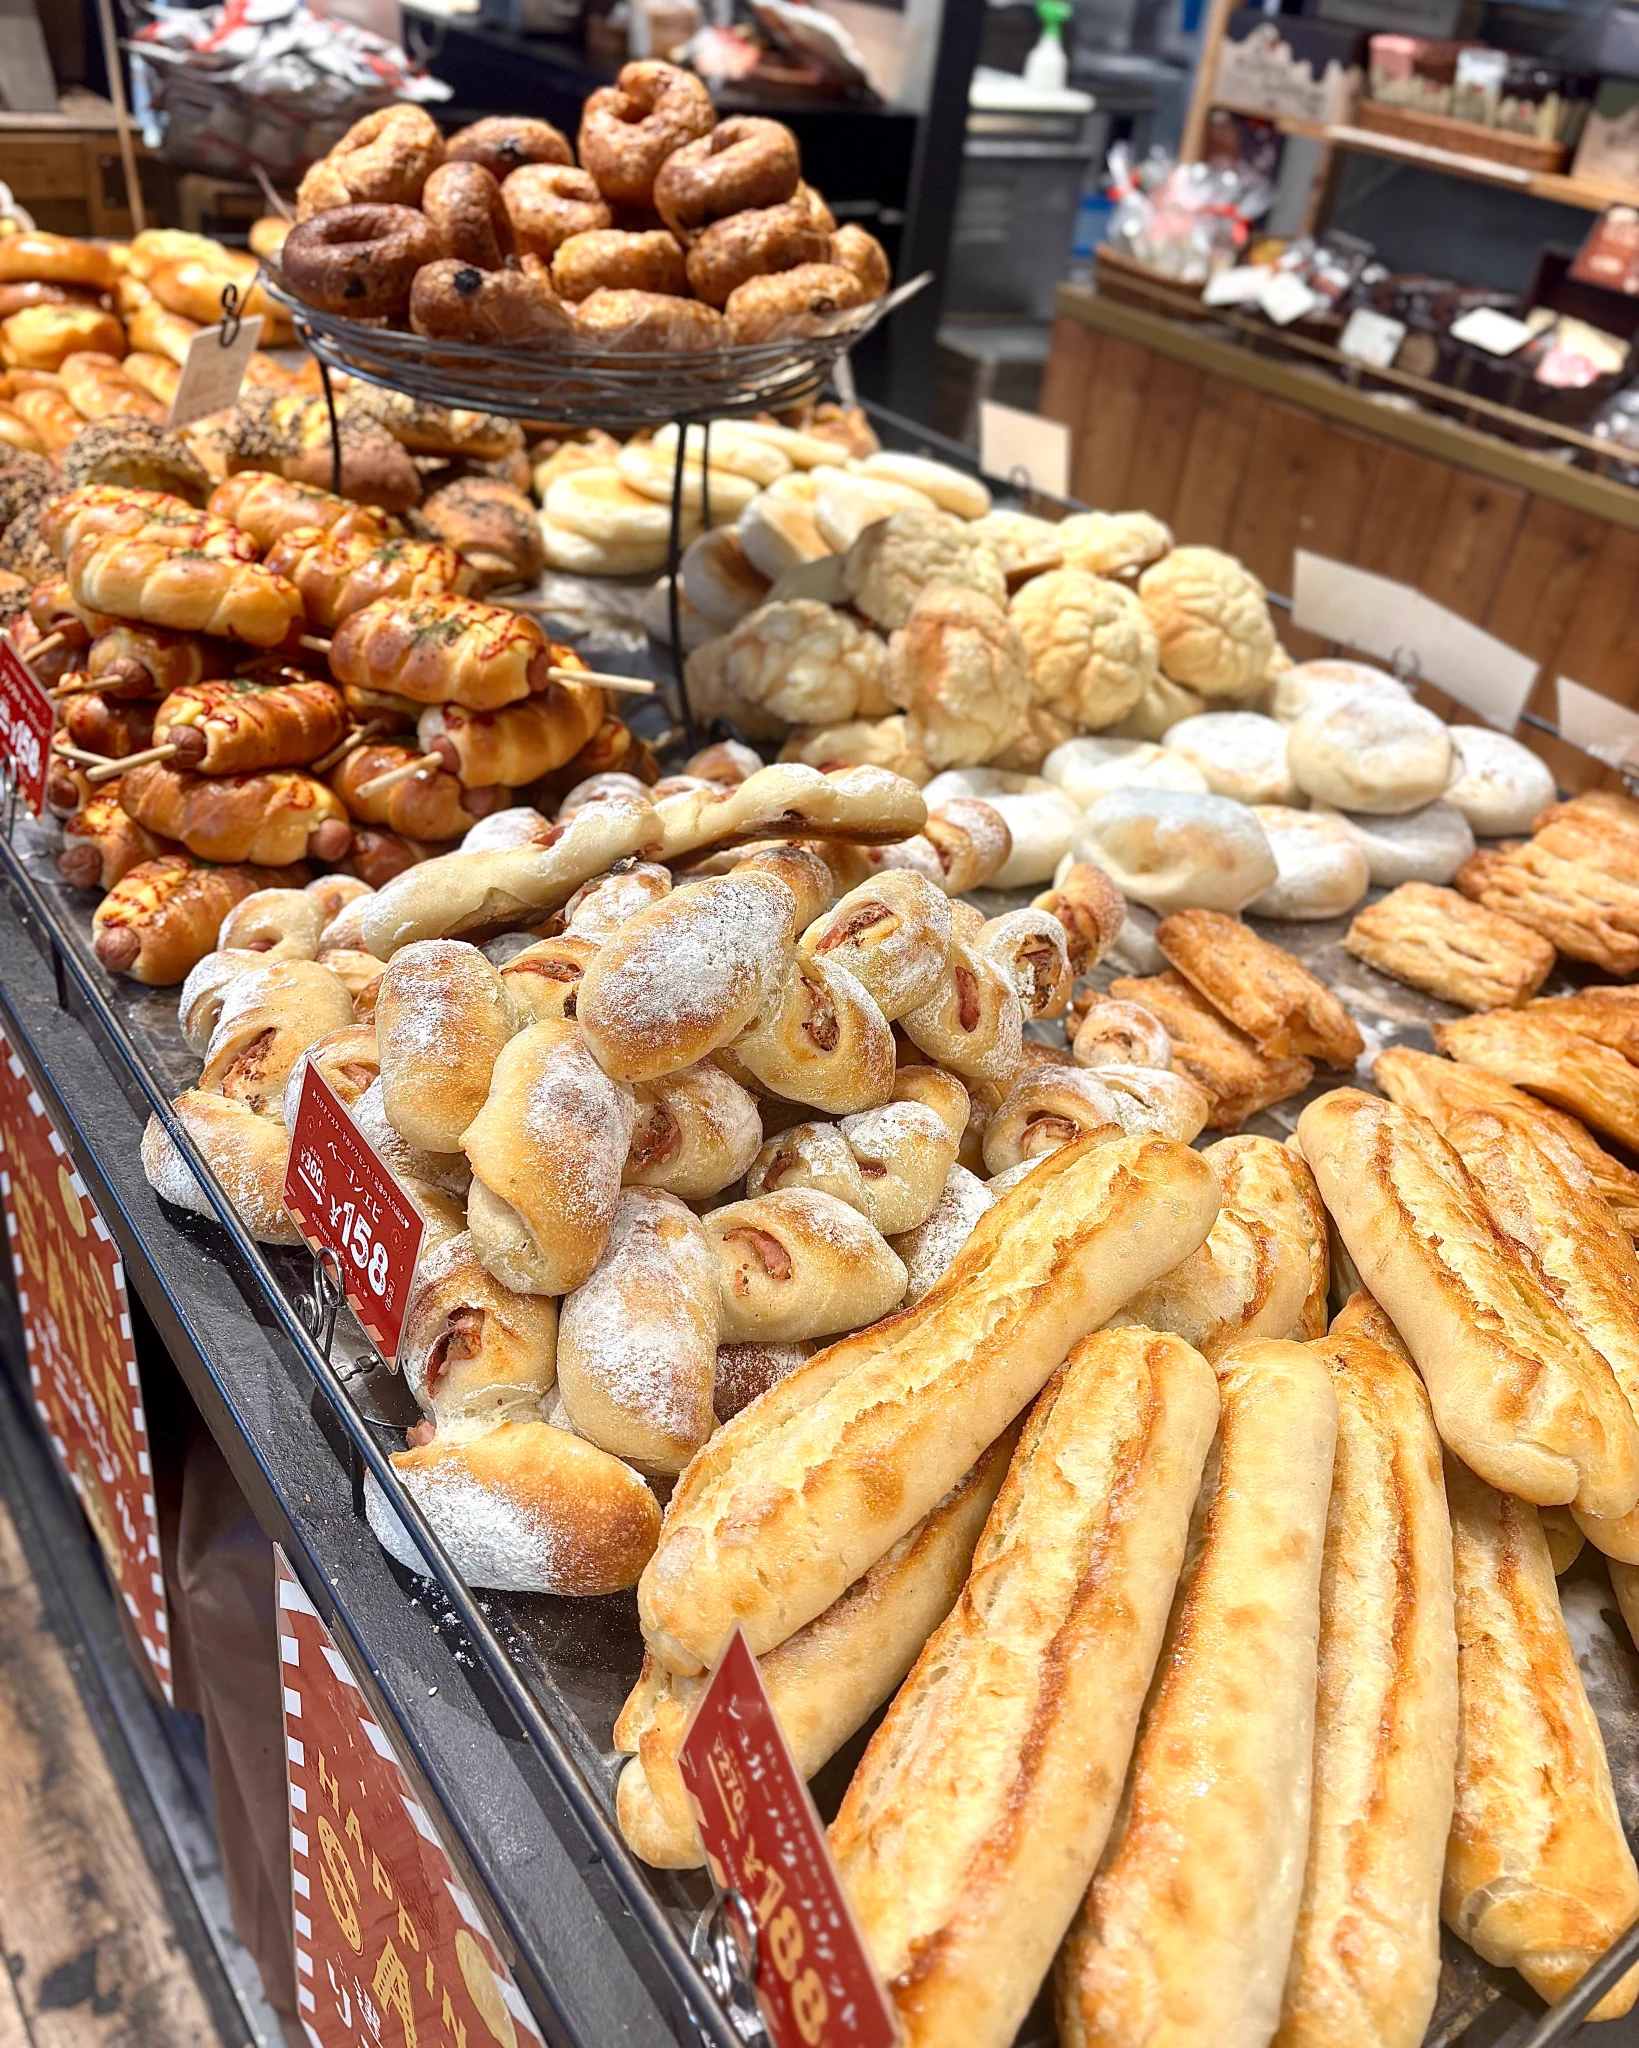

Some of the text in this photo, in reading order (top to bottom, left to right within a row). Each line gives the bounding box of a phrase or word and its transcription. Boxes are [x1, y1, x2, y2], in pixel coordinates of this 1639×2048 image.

[300, 1148, 322, 1187] ¥300
[327, 1141, 384, 1224] ベーコンエピ
[328, 1194, 388, 1296] ¥158
[13, 1179, 137, 1480] SALE
[713, 1736, 744, 1815] ¥270
[317, 1815, 418, 2048] SA
[318, 1747, 467, 2048] HAPPIN
[742, 1833, 829, 2047] ¥188
